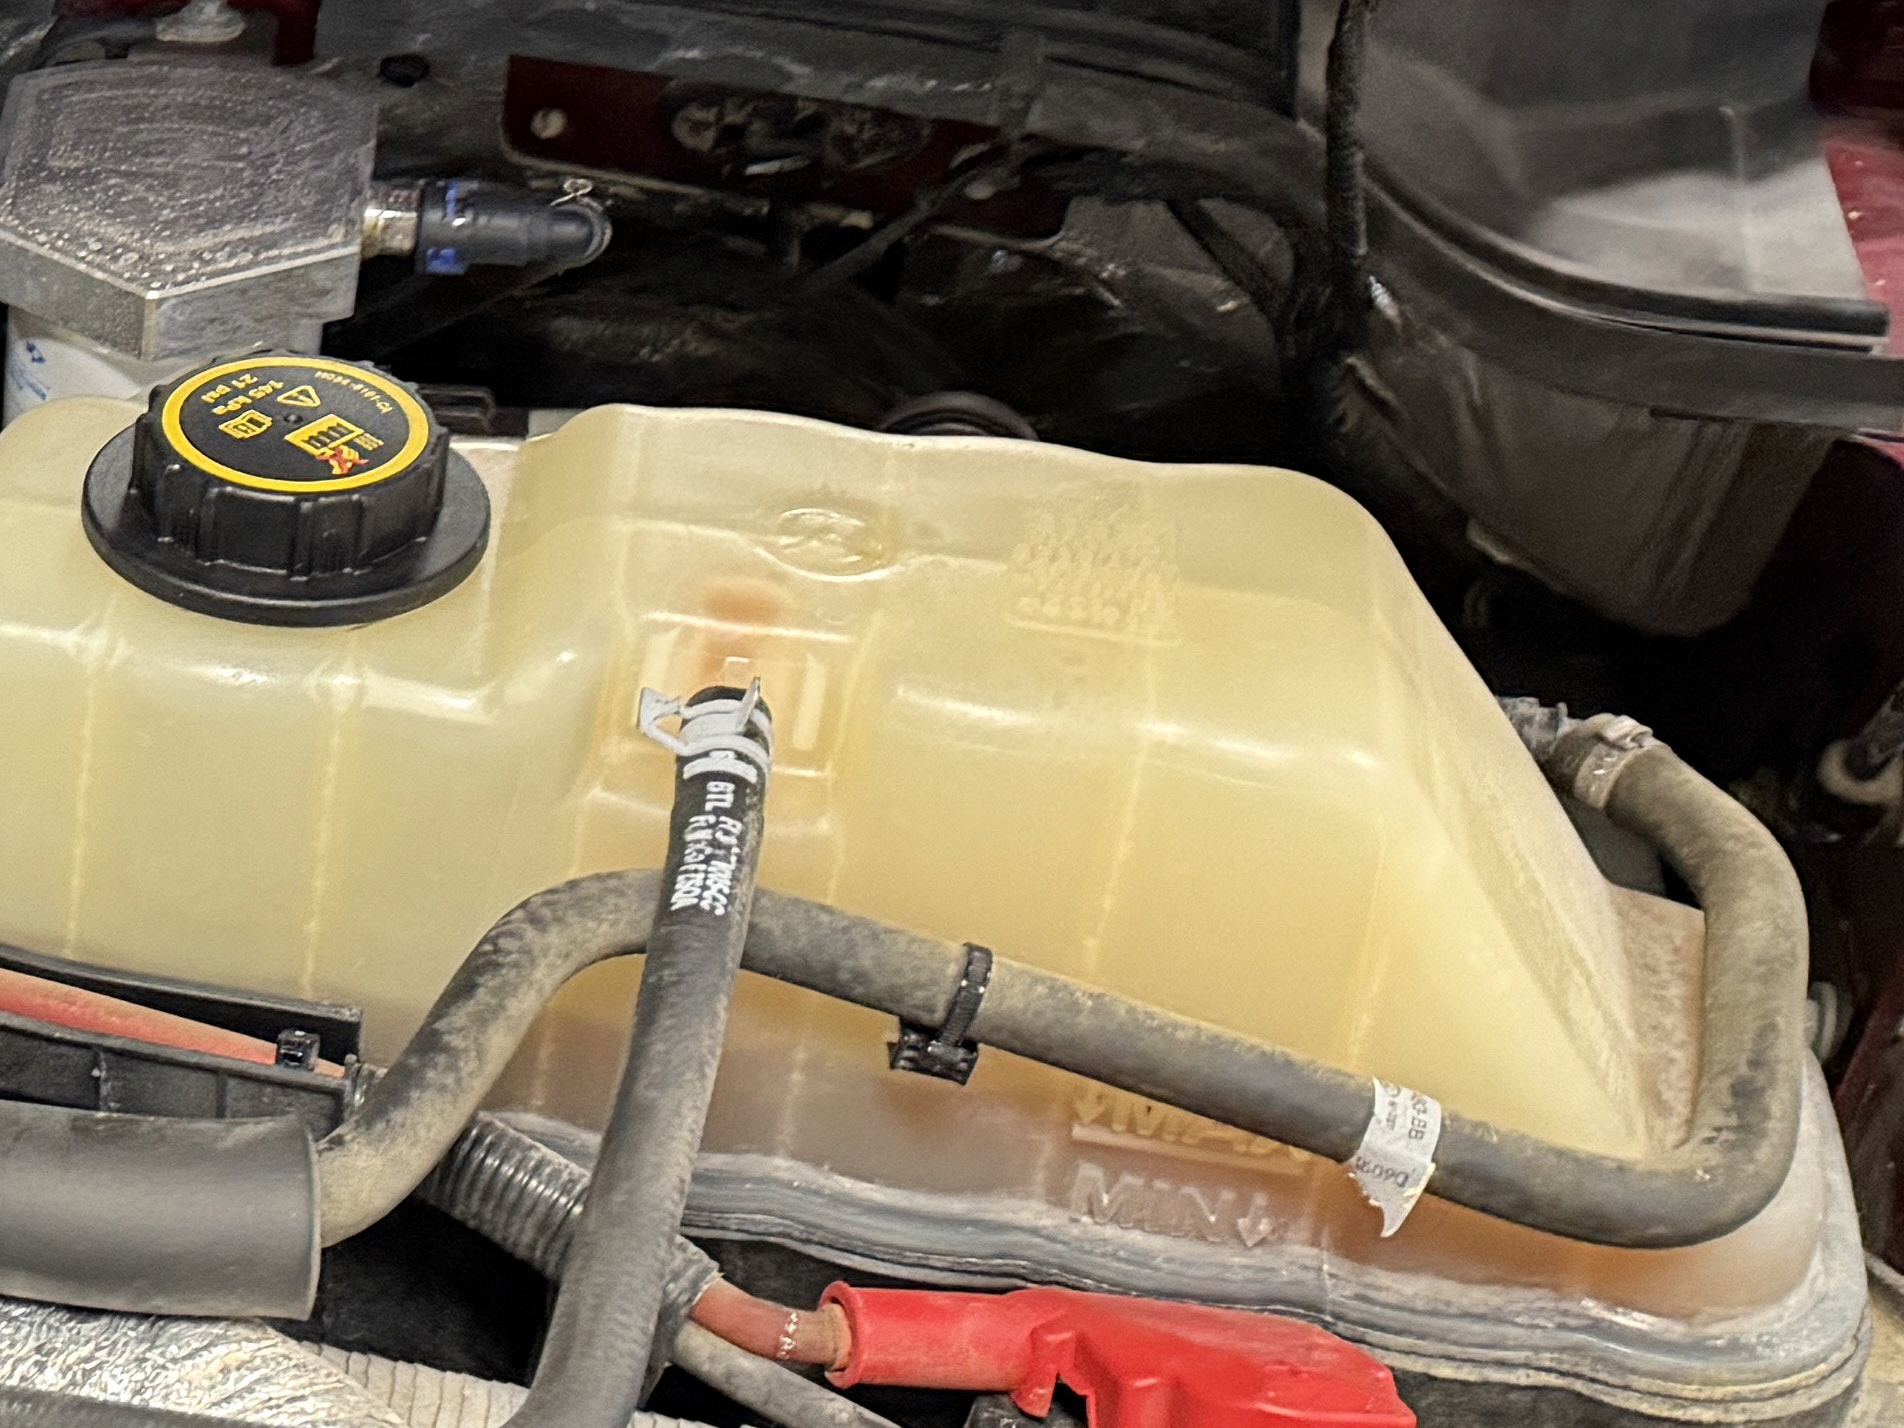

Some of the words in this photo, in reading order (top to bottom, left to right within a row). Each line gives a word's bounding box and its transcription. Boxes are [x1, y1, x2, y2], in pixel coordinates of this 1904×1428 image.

[232, 373, 260, 390] 21
[247, 379, 285, 400] 145
[201, 384, 232, 404] psi
[212, 395, 252, 416] kPa
[1069, 1160, 1238, 1244] MIN
